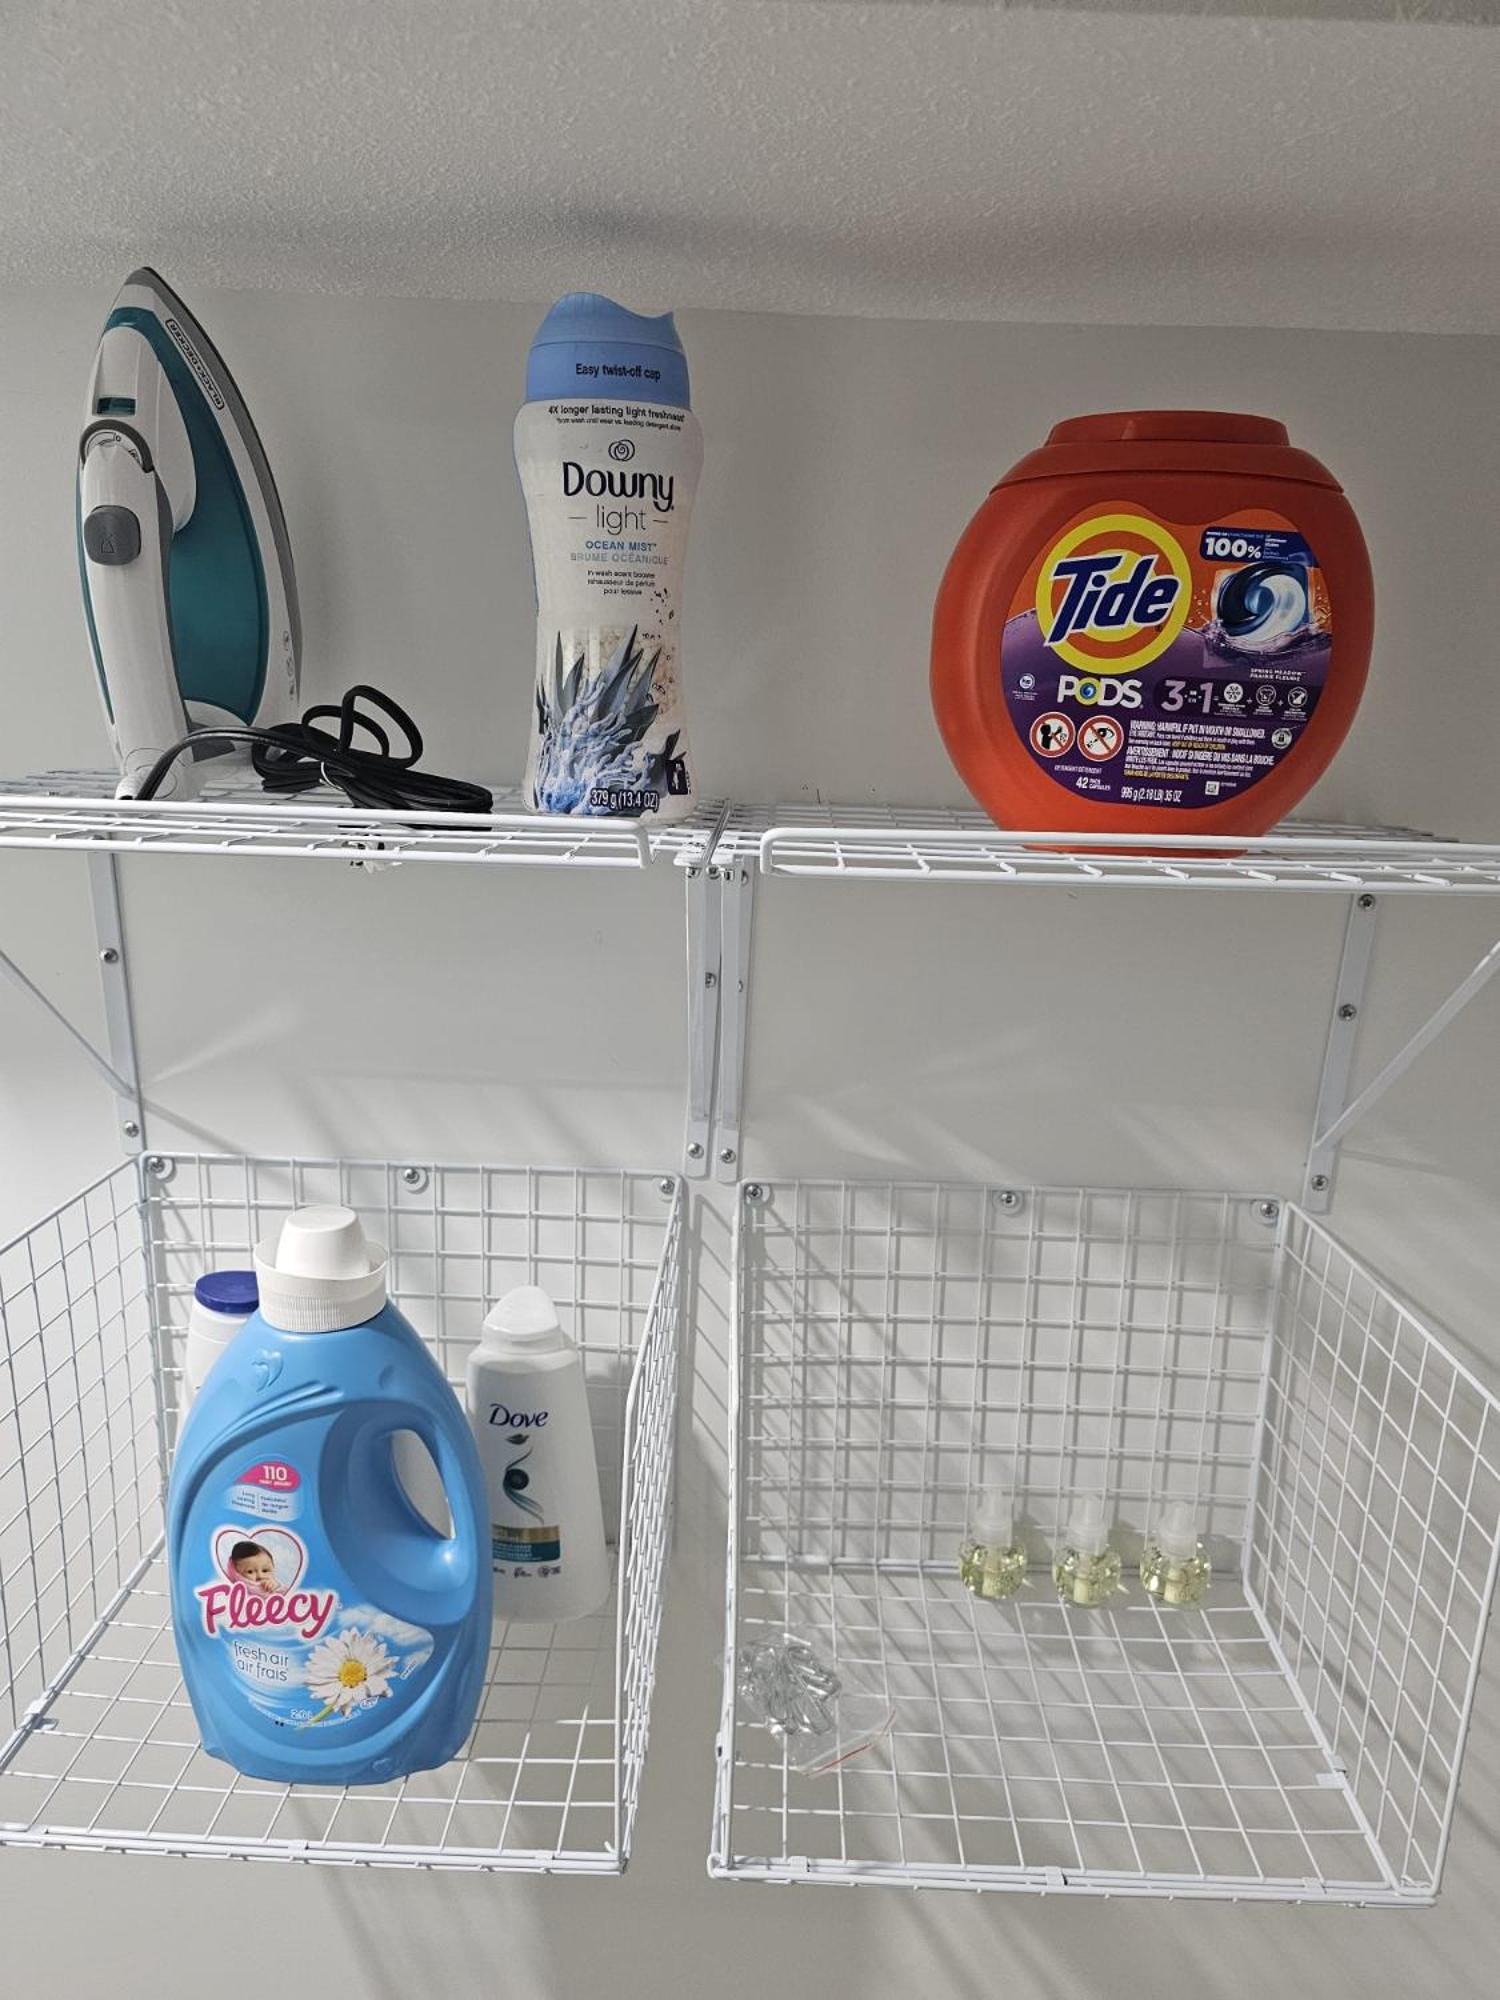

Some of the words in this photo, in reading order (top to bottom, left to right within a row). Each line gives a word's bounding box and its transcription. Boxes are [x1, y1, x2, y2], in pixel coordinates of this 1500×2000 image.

[575, 363, 599, 378] Easy
[601, 364, 642, 378] twist-off
[643, 368, 661, 383] cap
[548, 405, 558, 414] 4X
[560, 404, 589, 416] longer
[591, 405, 623, 417] lasting
[626, 406, 647, 418] light
[562, 461, 675, 513] Downy
[596, 503, 647, 536] light
[585, 540, 625, 551] OCEAN
[1205, 537, 1262, 560] 100%
[570, 552, 609, 563] BRUME
[1045, 554, 1181, 645] Tide
[1056, 674, 1143, 709] PODS
[1160, 679, 1187, 712] 3
[1199, 681, 1214, 714] 1
[1075, 776, 1089, 789] 42
[590, 789, 609, 806] 379
[610, 792, 618, 810] g
[618, 790, 641, 810] (13.4
[489, 1403, 550, 1428] Dove
[261, 1464, 288, 1481] 110
[197, 1581, 335, 1640] Fleecy
[234, 1640, 268, 1663] fresh
[269, 1653, 289, 1667] air
[236, 1659, 254, 1674] air
[255, 1662, 289, 1682] frais
